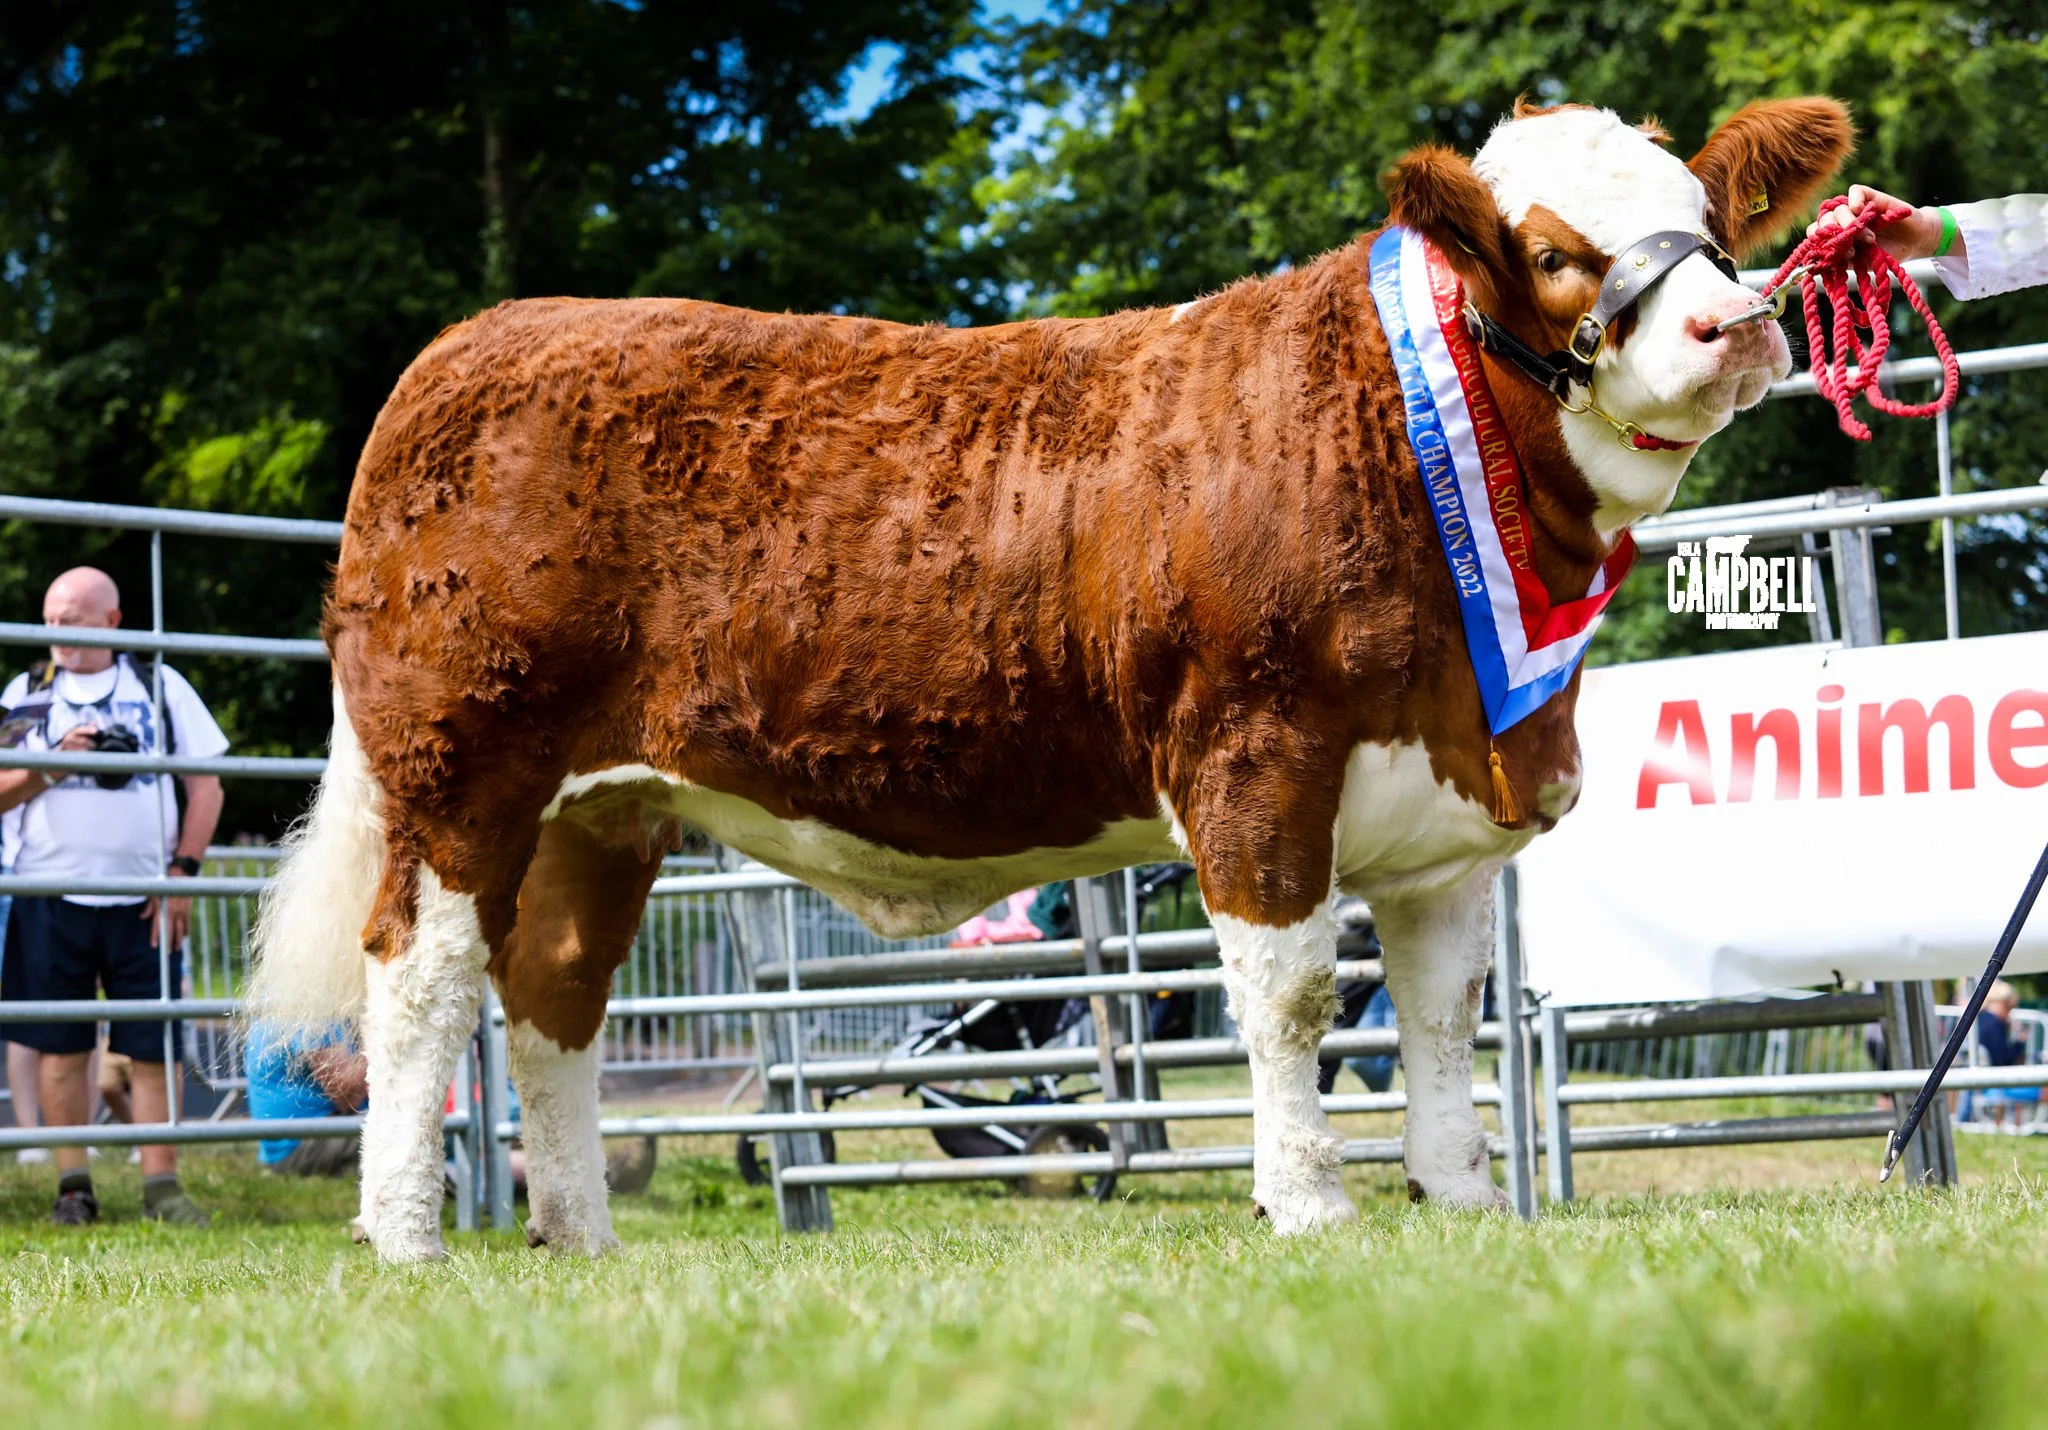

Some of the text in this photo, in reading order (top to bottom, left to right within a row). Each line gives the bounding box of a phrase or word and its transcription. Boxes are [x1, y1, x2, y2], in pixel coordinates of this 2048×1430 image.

[1415, 430, 1470, 551] CHAMPION
[1452, 552, 1483, 598] 2022
[1446, 326, 1530, 571] AGRICULTURAL SOCIETY
[1636, 684, 2048, 810] Anime
